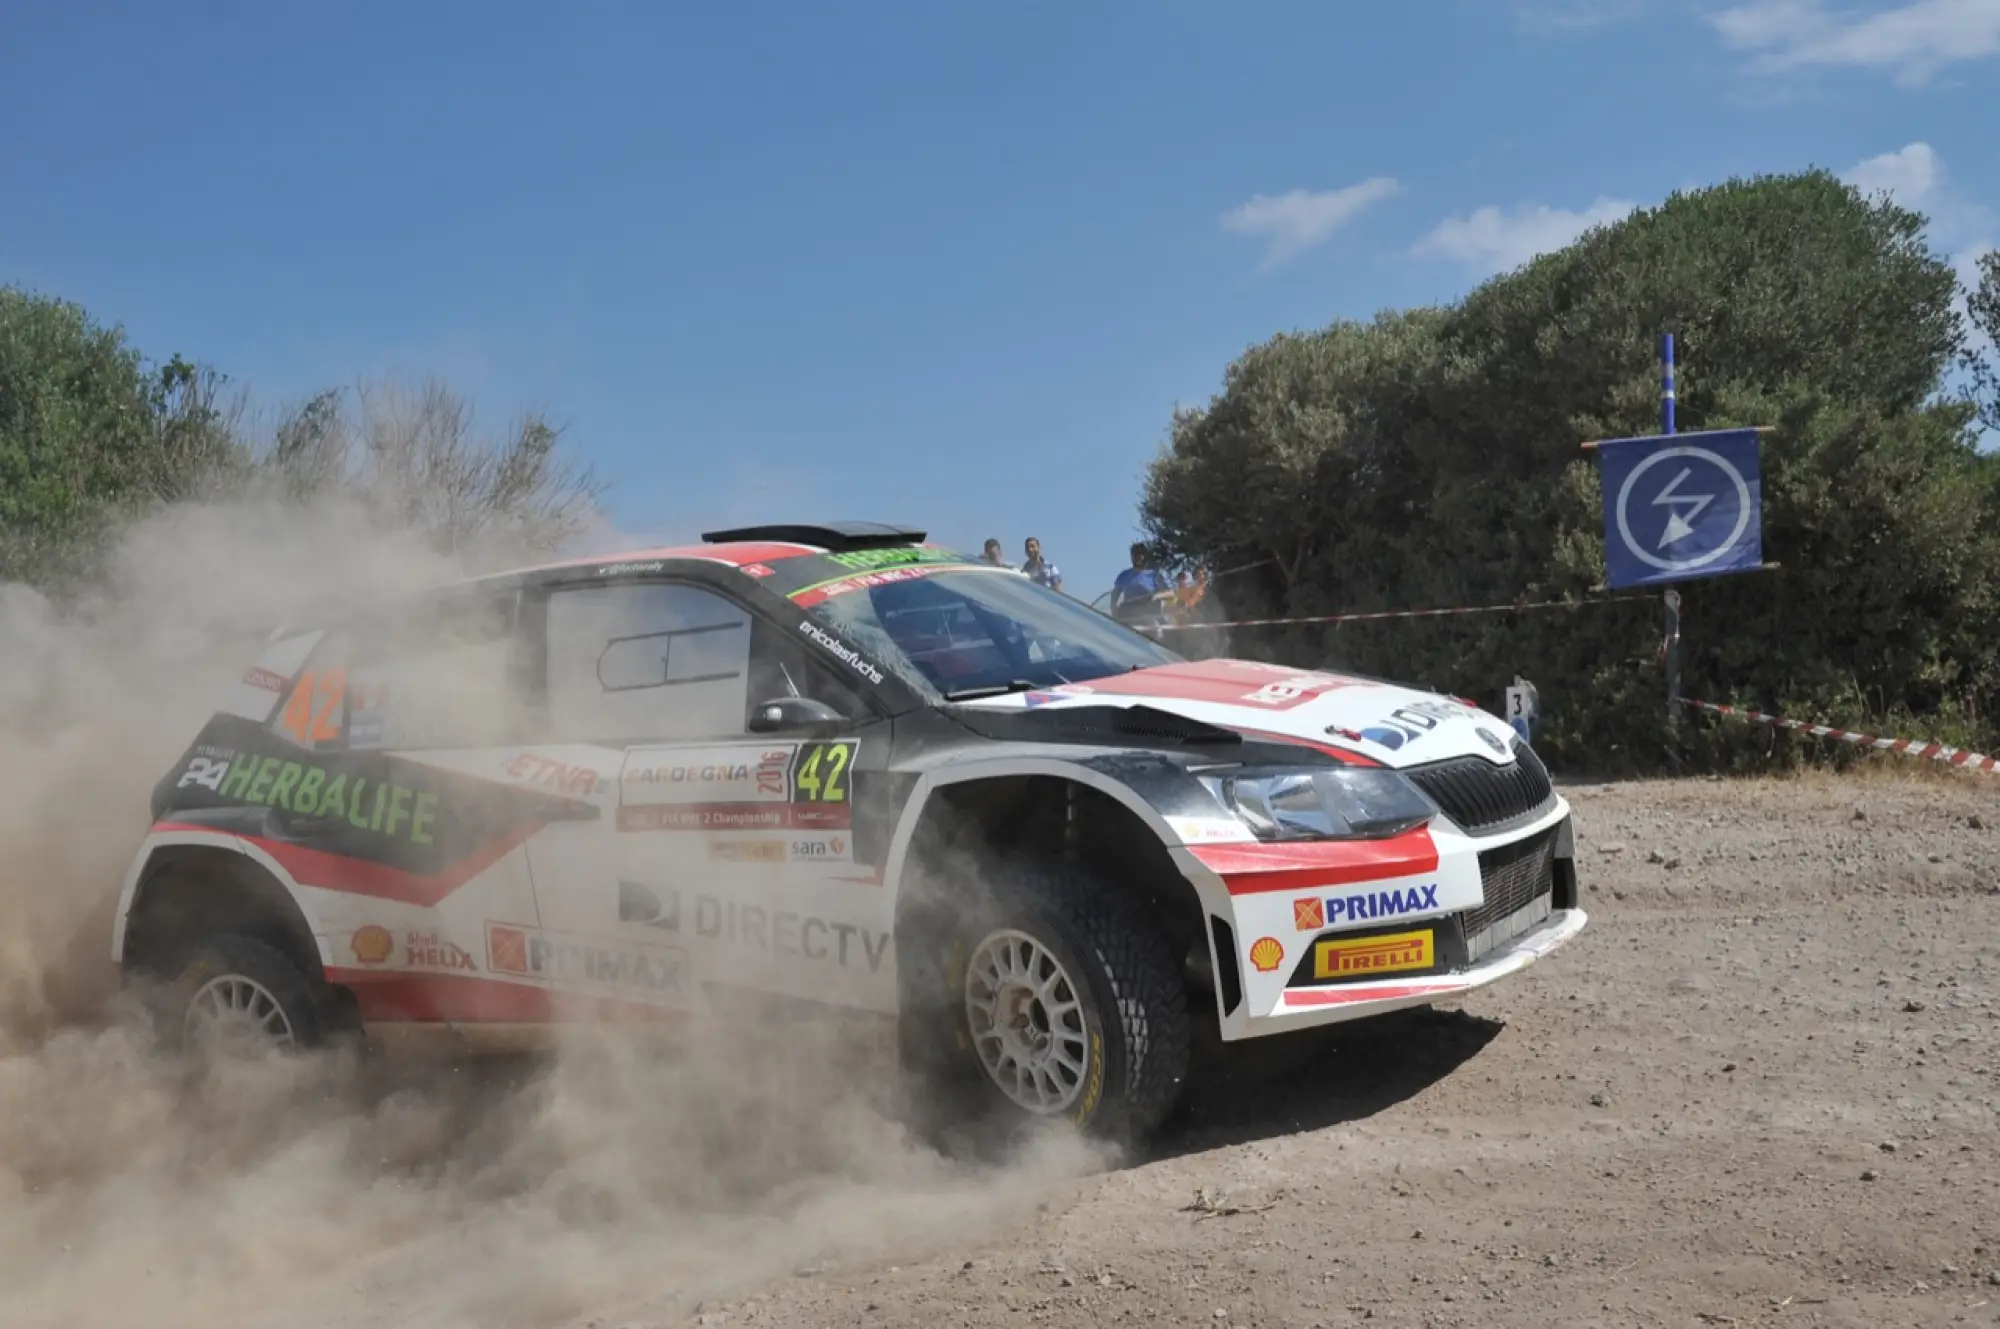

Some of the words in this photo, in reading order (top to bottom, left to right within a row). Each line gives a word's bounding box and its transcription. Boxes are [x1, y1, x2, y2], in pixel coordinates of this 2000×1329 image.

[283, 666, 347, 742] 42
[1512, 694, 1522, 716] 3
[177, 757, 230, 791] 24
[625, 765, 749, 784] SARDEGNA
[756, 751, 788, 795] 2016
[797, 744, 849, 801] 42
[221, 753, 438, 845] HERBALIFE
[703, 812, 710, 824] 2
[713, 810, 781, 826] Championship
[792, 839, 826, 856] sara
[1326, 884, 1439, 924] PRIMAX
[696, 893, 890, 974] DIRECTV
[1328, 939, 1423, 971] PIRELLI
